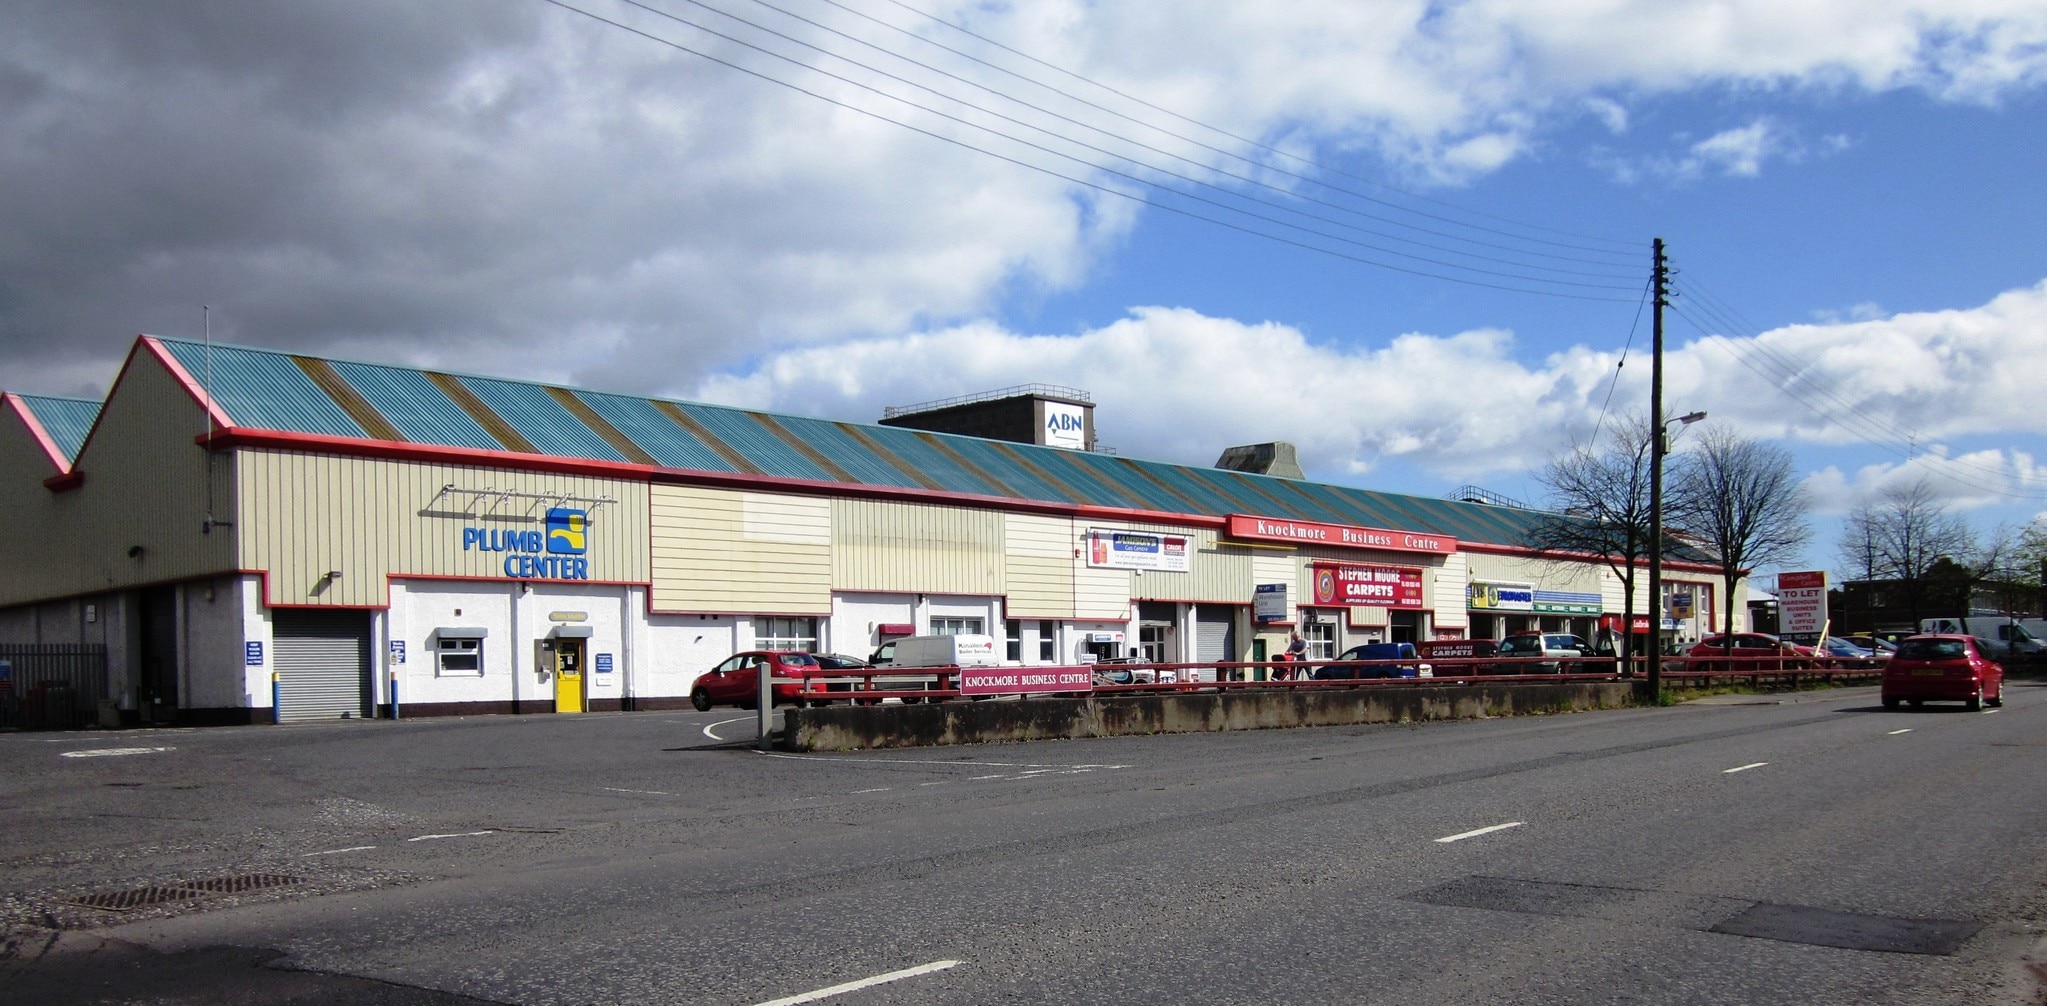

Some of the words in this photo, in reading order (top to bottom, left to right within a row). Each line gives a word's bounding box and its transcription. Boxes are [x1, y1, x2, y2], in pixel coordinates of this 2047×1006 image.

[1048, 412, 1082, 431] ABN
[463, 527, 544, 553] PLUMB
[1115, 535, 1157, 547] JAMISON'S
[1257, 520, 1326, 540] Knockmore
[1342, 529, 1391, 545] Business
[1404, 535, 1439, 549] Centre
[504, 555, 588, 580] CENTER
[1338, 566, 1372, 581] STEPHEN
[1374, 568, 1401, 583] MOORE
[1346, 583, 1394, 597] CARPETS
[1783, 590, 1797, 598] TO
[965, 675, 1018, 687] KNOCKMORE
[1021, 674, 1056, 685] BUSINESS
[1059, 673, 1088, 684] CENTRE
